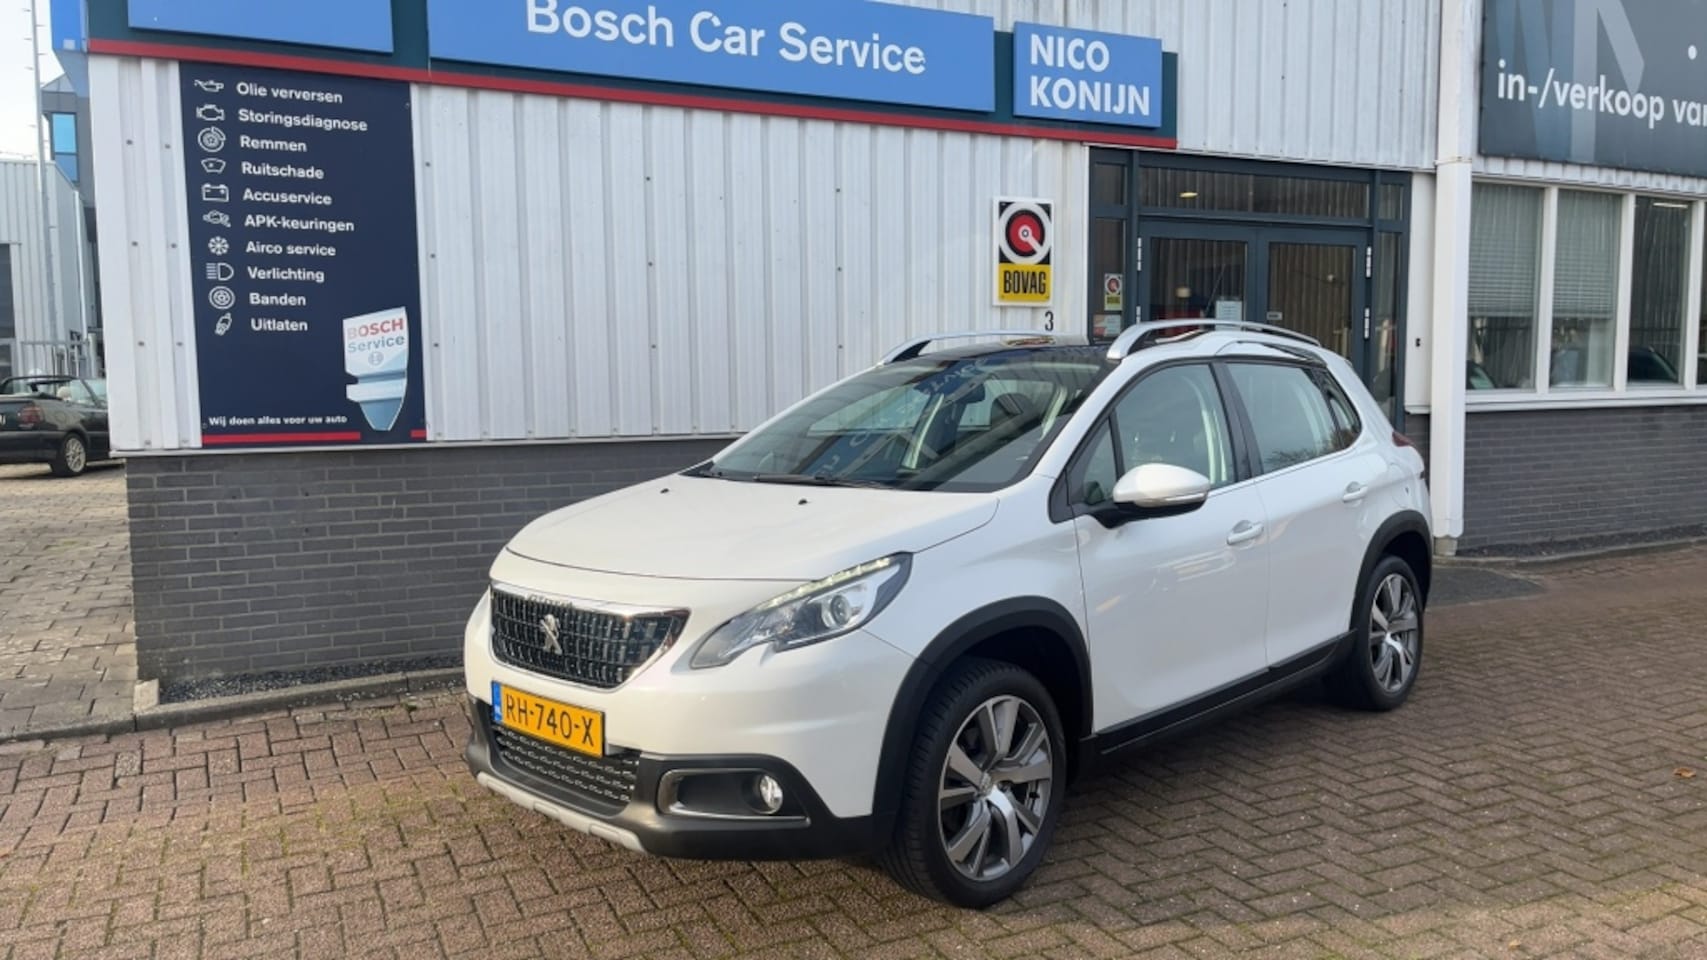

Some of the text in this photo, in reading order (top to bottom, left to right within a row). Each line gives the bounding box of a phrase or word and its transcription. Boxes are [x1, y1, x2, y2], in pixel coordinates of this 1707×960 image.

[526, 0, 926, 75] Bosch Car Service
[1030, 33, 1110, 73] NICO
[236, 81, 343, 104] Olie verversen
[1030, 75, 1150, 116] KONIJN
[1497, 58, 1665, 129] in-/verkoop
[238, 108, 368, 132] Storingsdiagnose
[240, 135, 307, 152] Remmen
[241, 161, 325, 180] Ruitschade
[243, 188, 333, 205] Accuservice
[244, 214, 355, 233] APK-keuringen
[246, 241, 337, 256] Airco service
[247, 266, 325, 283] Verlichting
[1003, 270, 1047, 295] BOVAG
[250, 292, 307, 306] Banden
[251, 317, 308, 332] Uitlaten
[347, 317, 405, 339] BOSCH
[1044, 310, 1054, 332] 3
[348, 335, 406, 354] Service
[209, 415, 348, 429] Wij doen alles voor uw auto
[505, 693, 594, 747] RH-740-X
